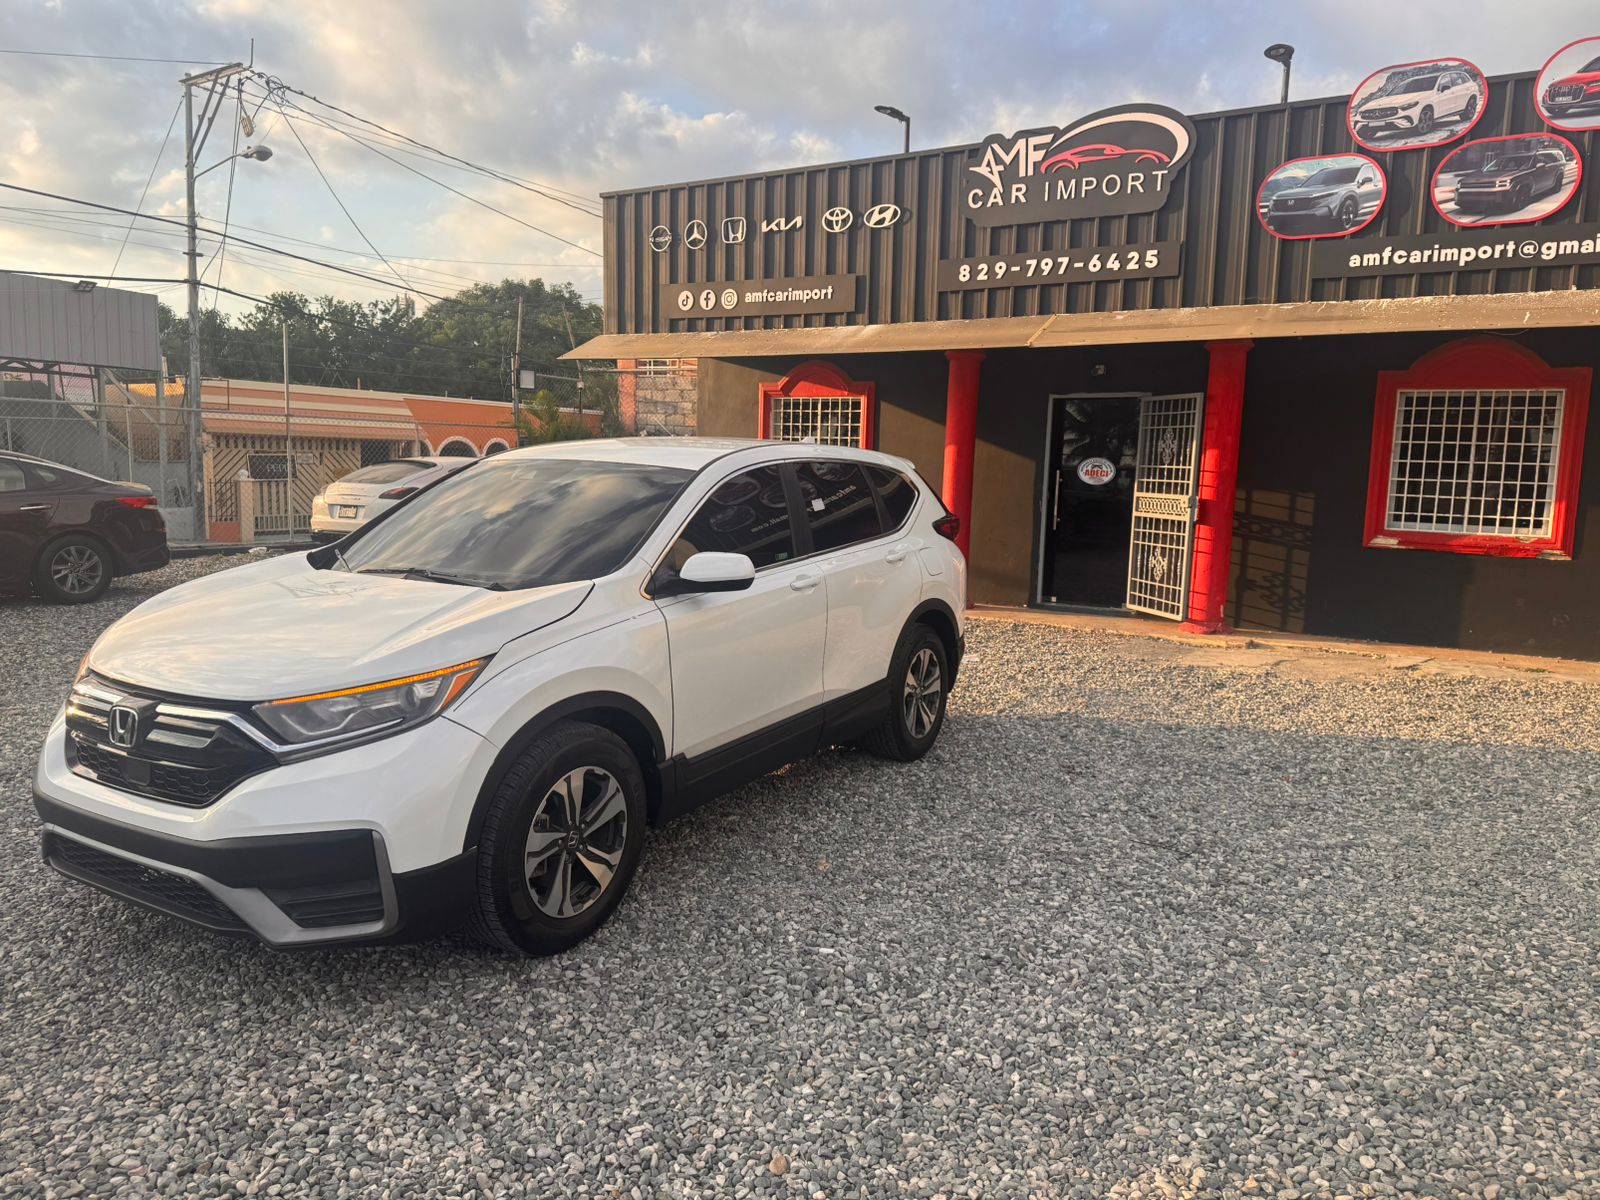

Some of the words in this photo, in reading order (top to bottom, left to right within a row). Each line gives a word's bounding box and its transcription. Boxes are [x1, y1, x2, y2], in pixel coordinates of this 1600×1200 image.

[967, 183, 1027, 209] CAR
[1044, 170, 1169, 202] IMPORT
[958, 249, 1159, 282] 829-797-6425
[744, 285, 834, 304] amfcarimport
[1084, 468, 1110, 478] ADECI
